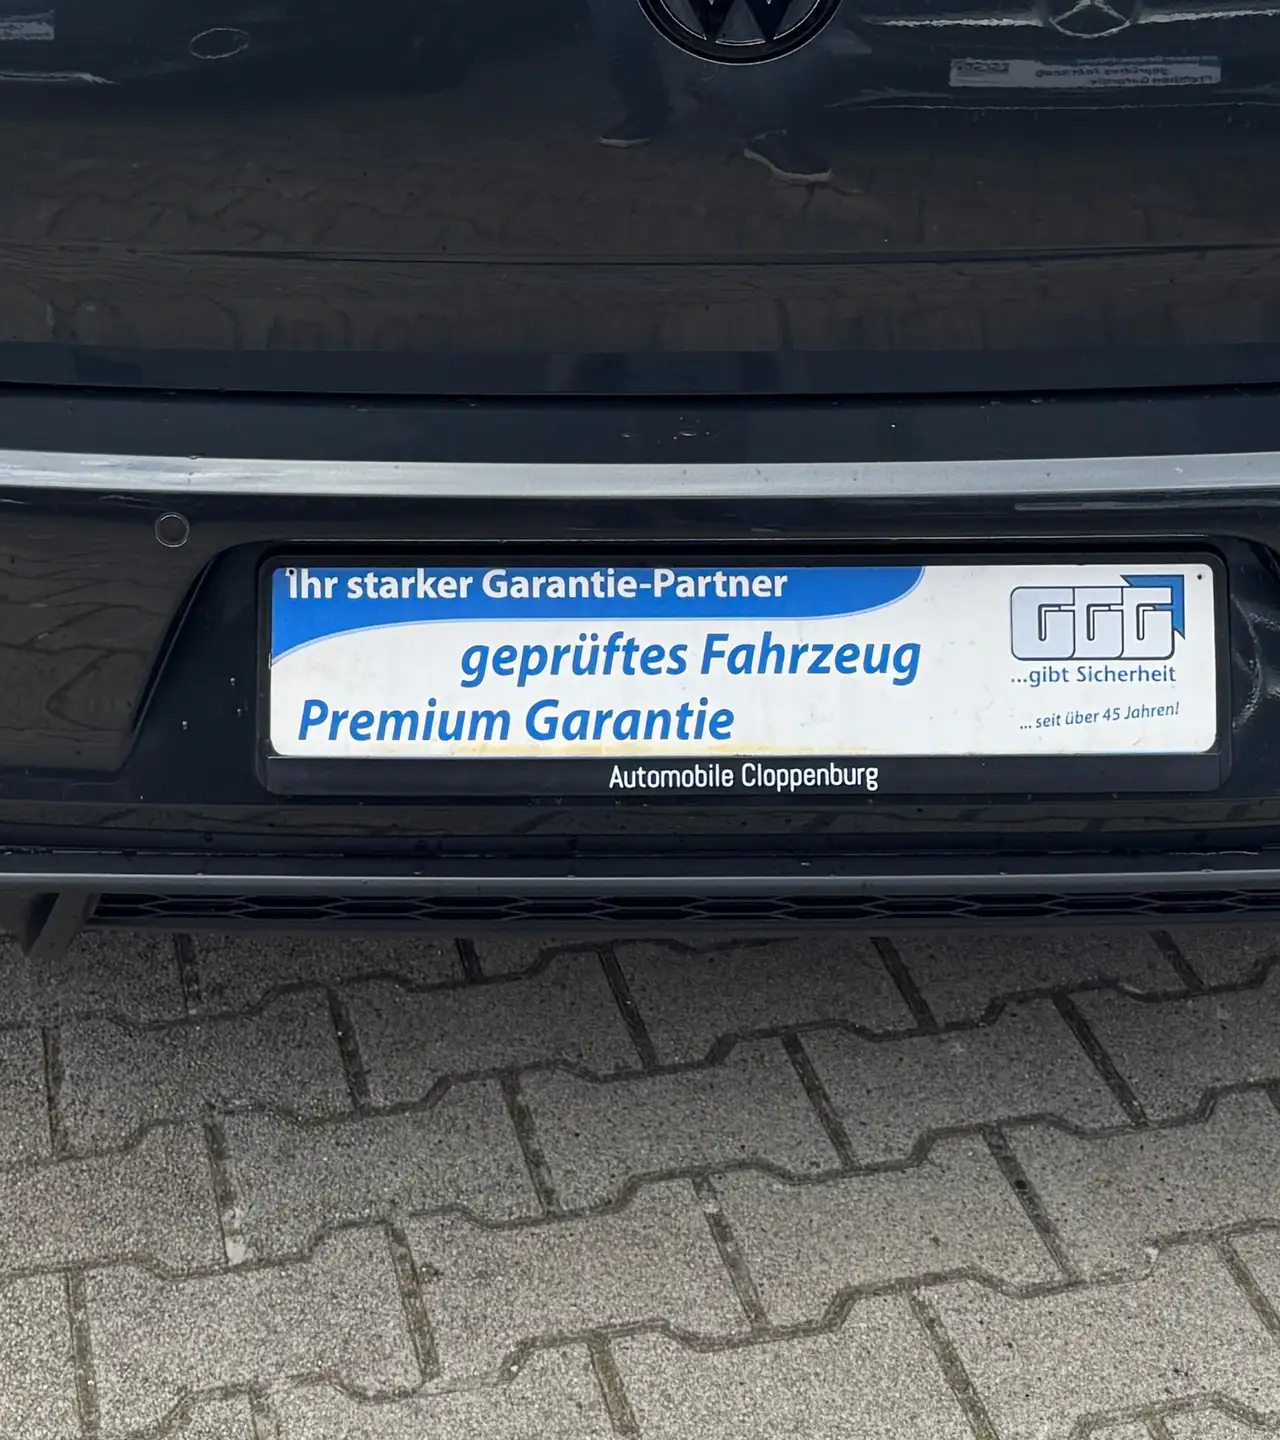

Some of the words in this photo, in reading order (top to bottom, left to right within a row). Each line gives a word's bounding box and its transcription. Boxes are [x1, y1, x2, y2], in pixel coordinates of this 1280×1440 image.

[285, 568, 339, 599] Ihr
[347, 568, 474, 599] starker
[482, 568, 788, 599] Garantie-Partner
[461, 631, 688, 688] geprüftes
[700, 631, 921, 687] Fahrzeug
[1011, 666, 1070, 688] ...gibt
[1076, 664, 1177, 683] Sicherheit
[298, 697, 511, 741] Premium
[525, 697, 735, 741] Garantie
[1035, 713, 1061, 729] seit
[1065, 709, 1100, 725] über
[1102, 707, 1121, 721] 45
[1124, 701, 1180, 720] Jahren!
[609, 764, 734, 789] Automobile
[741, 763, 879, 793] Cloppenburg
